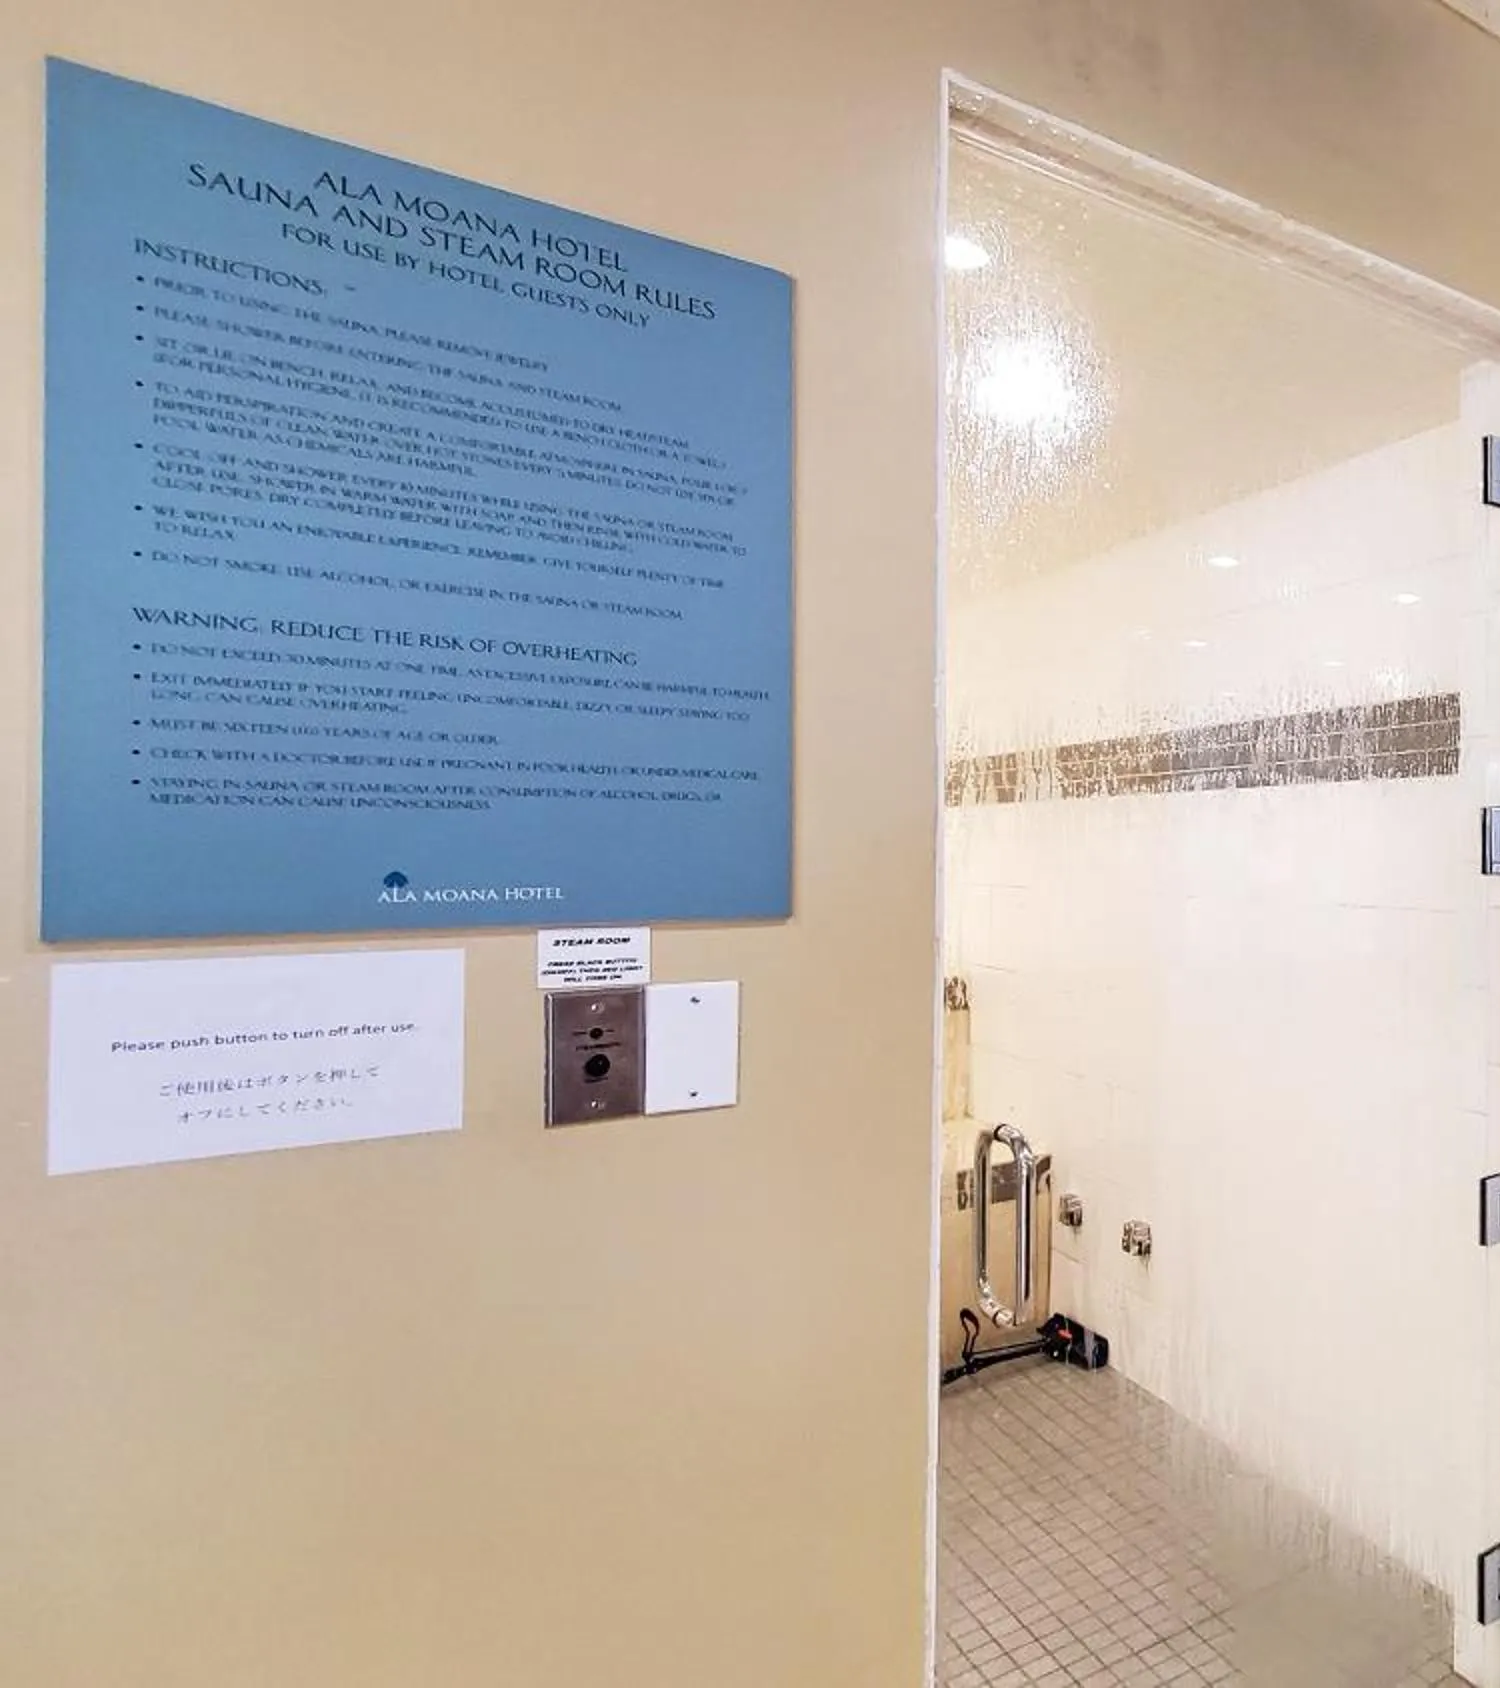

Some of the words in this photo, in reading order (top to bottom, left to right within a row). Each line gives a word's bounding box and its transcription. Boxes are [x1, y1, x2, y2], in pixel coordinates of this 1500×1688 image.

[188, 162, 318, 220] SAUNA
[332, 200, 407, 243] AND
[419, 223, 524, 273] STEAM
[535, 254, 625, 298] ROOM
[636, 280, 715, 321] RULES
[313, 168, 382, 207] ALA
[394, 190, 520, 243] MOANA
[531, 228, 628, 272] HOTEL
[282, 222, 335, 253] FOR
[343, 238, 386, 265] USE
[395, 251, 419, 273] BY
[428, 259, 504, 294] HOTEL
[512, 280, 589, 315] GUESTS
[595, 301, 650, 329] ONLY
[271, 619, 365, 644] REDUCE
[372, 628, 413, 648] THE
[419, 633, 464, 652] RISK
[469, 637, 496, 655] OF
[503, 640, 637, 667] OVERHEATING
[376, 885, 417, 903] ALA
[423, 887, 499, 902] MOANA
[505, 886, 564, 901] HOTEL
[552, 938, 594, 947] STEAM
[596, 937, 631, 945] ROOM
[111, 1040, 165, 1053] Please
[170, 1036, 209, 1051] push
[214, 1033, 269, 1046] button
[272, 1031, 288, 1041] to
[293, 1029, 324, 1040] turn
[328, 1025, 350, 1038] off
[351, 1023, 387, 1036] after
